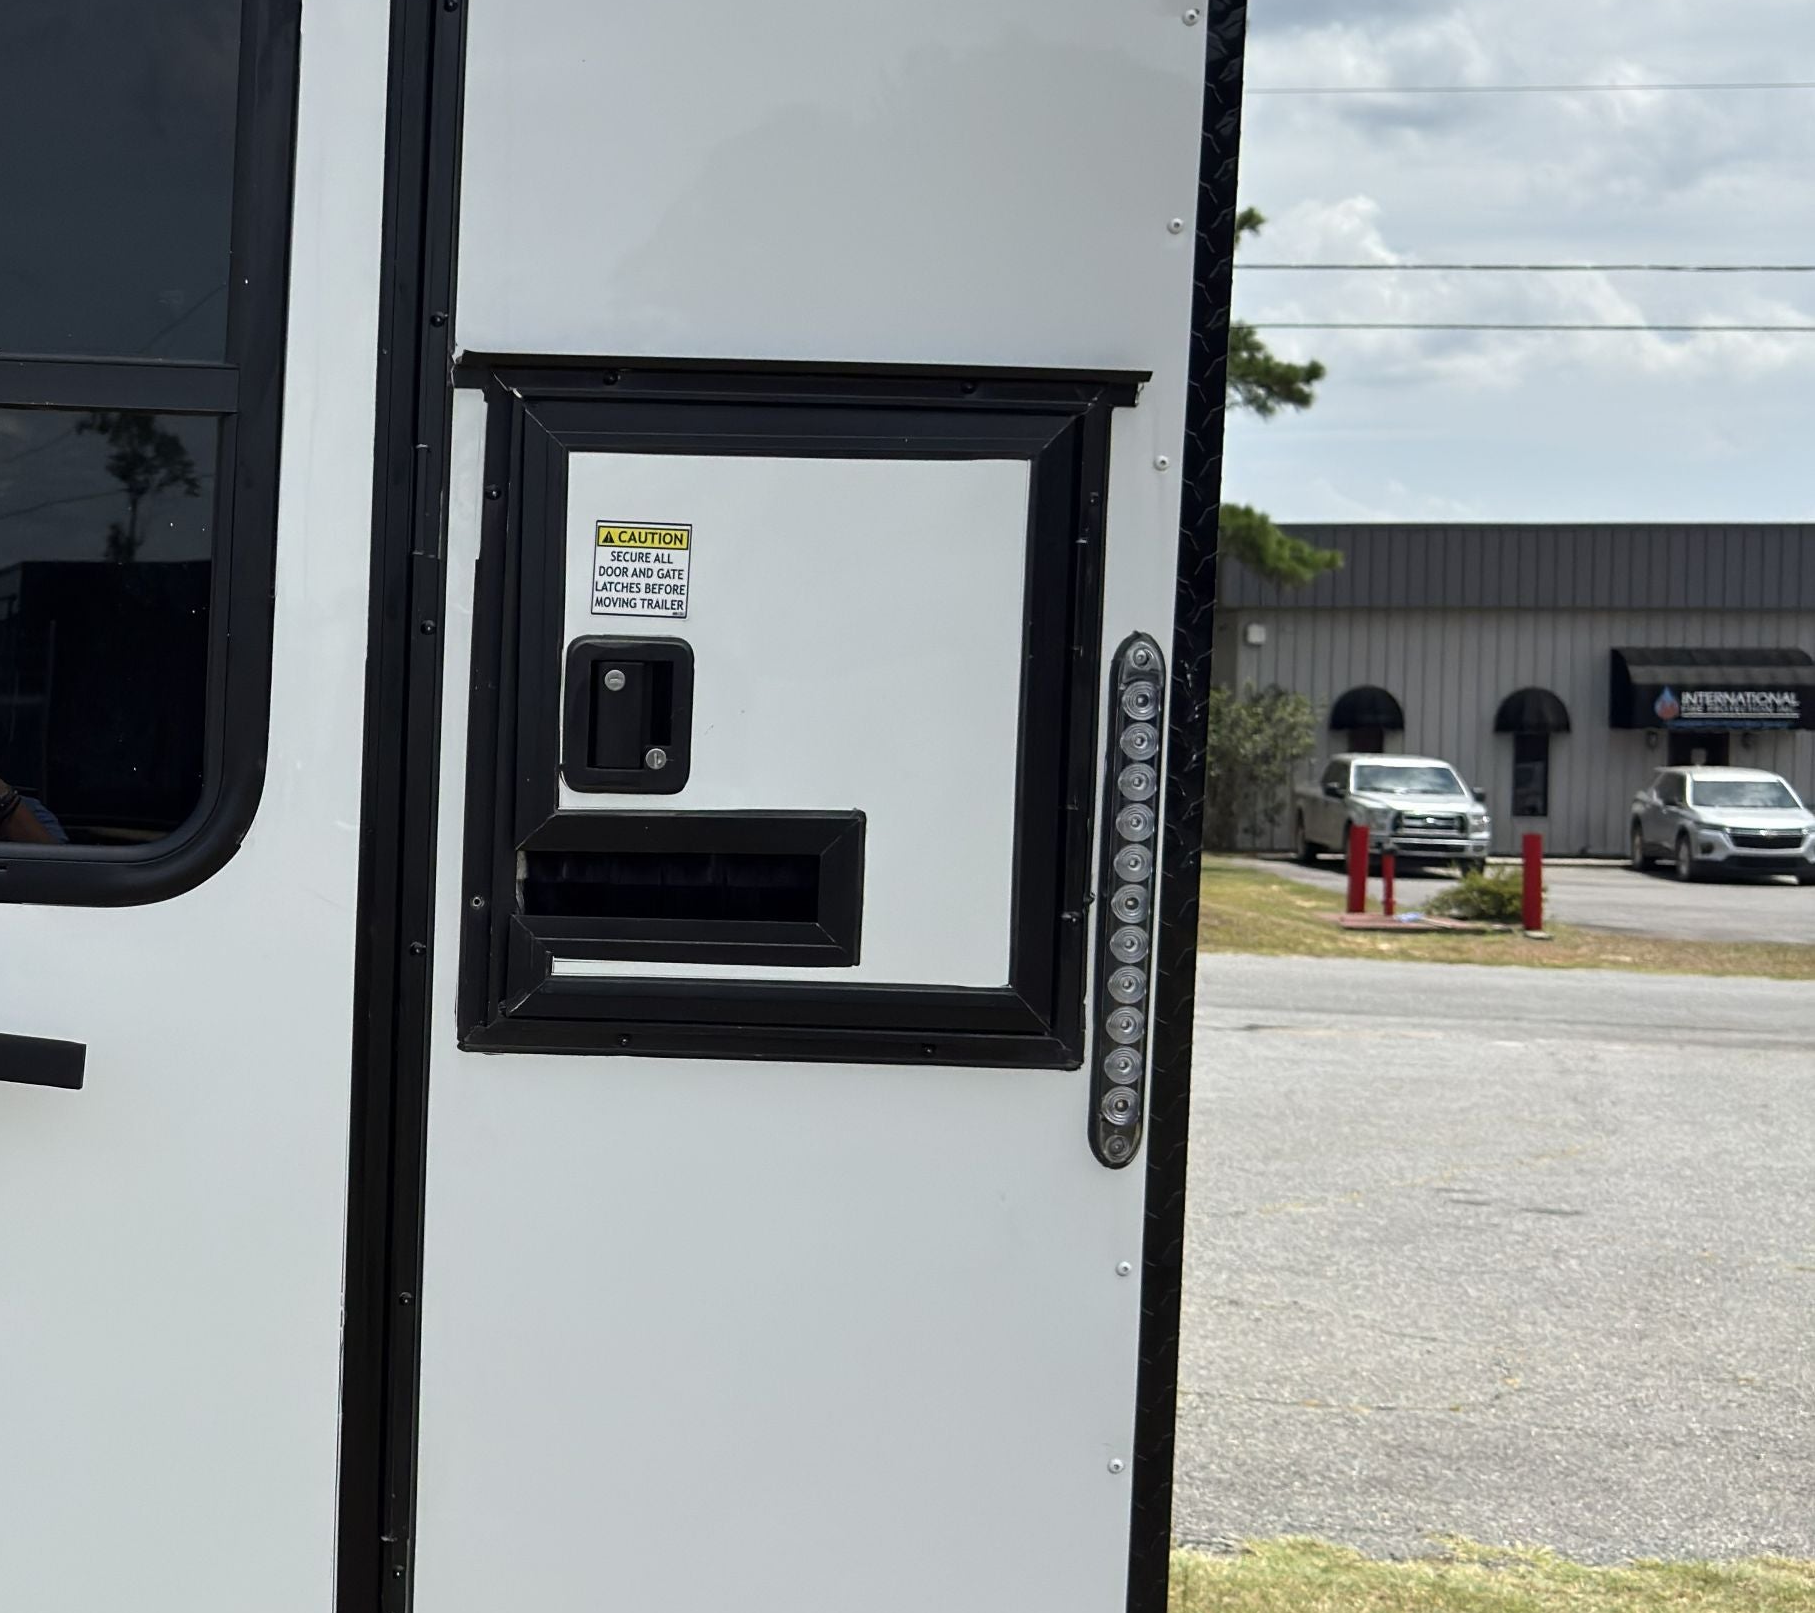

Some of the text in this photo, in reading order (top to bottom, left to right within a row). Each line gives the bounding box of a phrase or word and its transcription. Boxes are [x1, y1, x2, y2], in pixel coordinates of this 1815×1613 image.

[618, 530, 684, 546] CAUTION
[610, 550, 673, 564] SECURE ALL
[598, 565, 684, 580] DOOR AND GATE
[595, 581, 686, 596] LATCHES BEFORE
[594, 596, 684, 611] MOVING TRAILER
[1680, 690, 1801, 706] INTERNATIONAL
